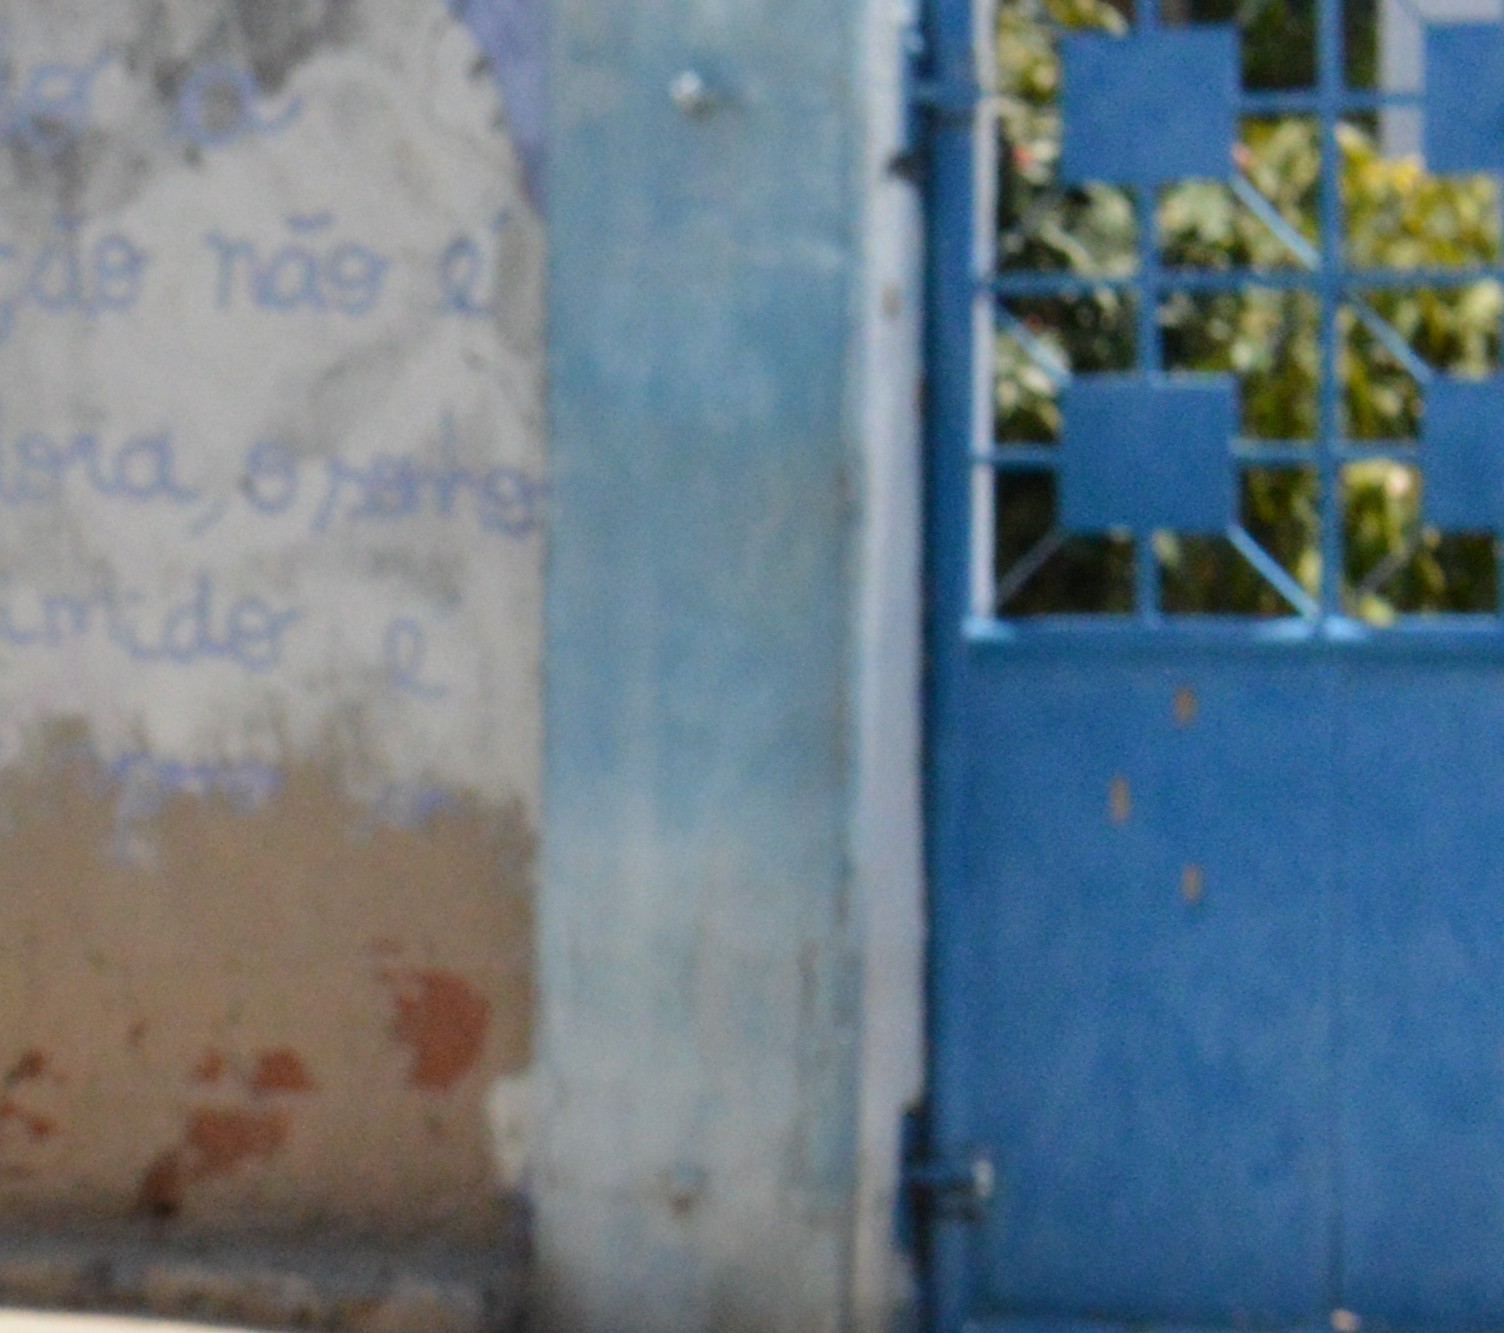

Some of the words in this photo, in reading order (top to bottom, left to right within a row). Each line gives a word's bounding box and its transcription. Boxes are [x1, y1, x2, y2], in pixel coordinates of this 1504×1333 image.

[200, 210, 392, 317] não
[433, 210, 512, 318] é
[240, 440, 300, 516] o
